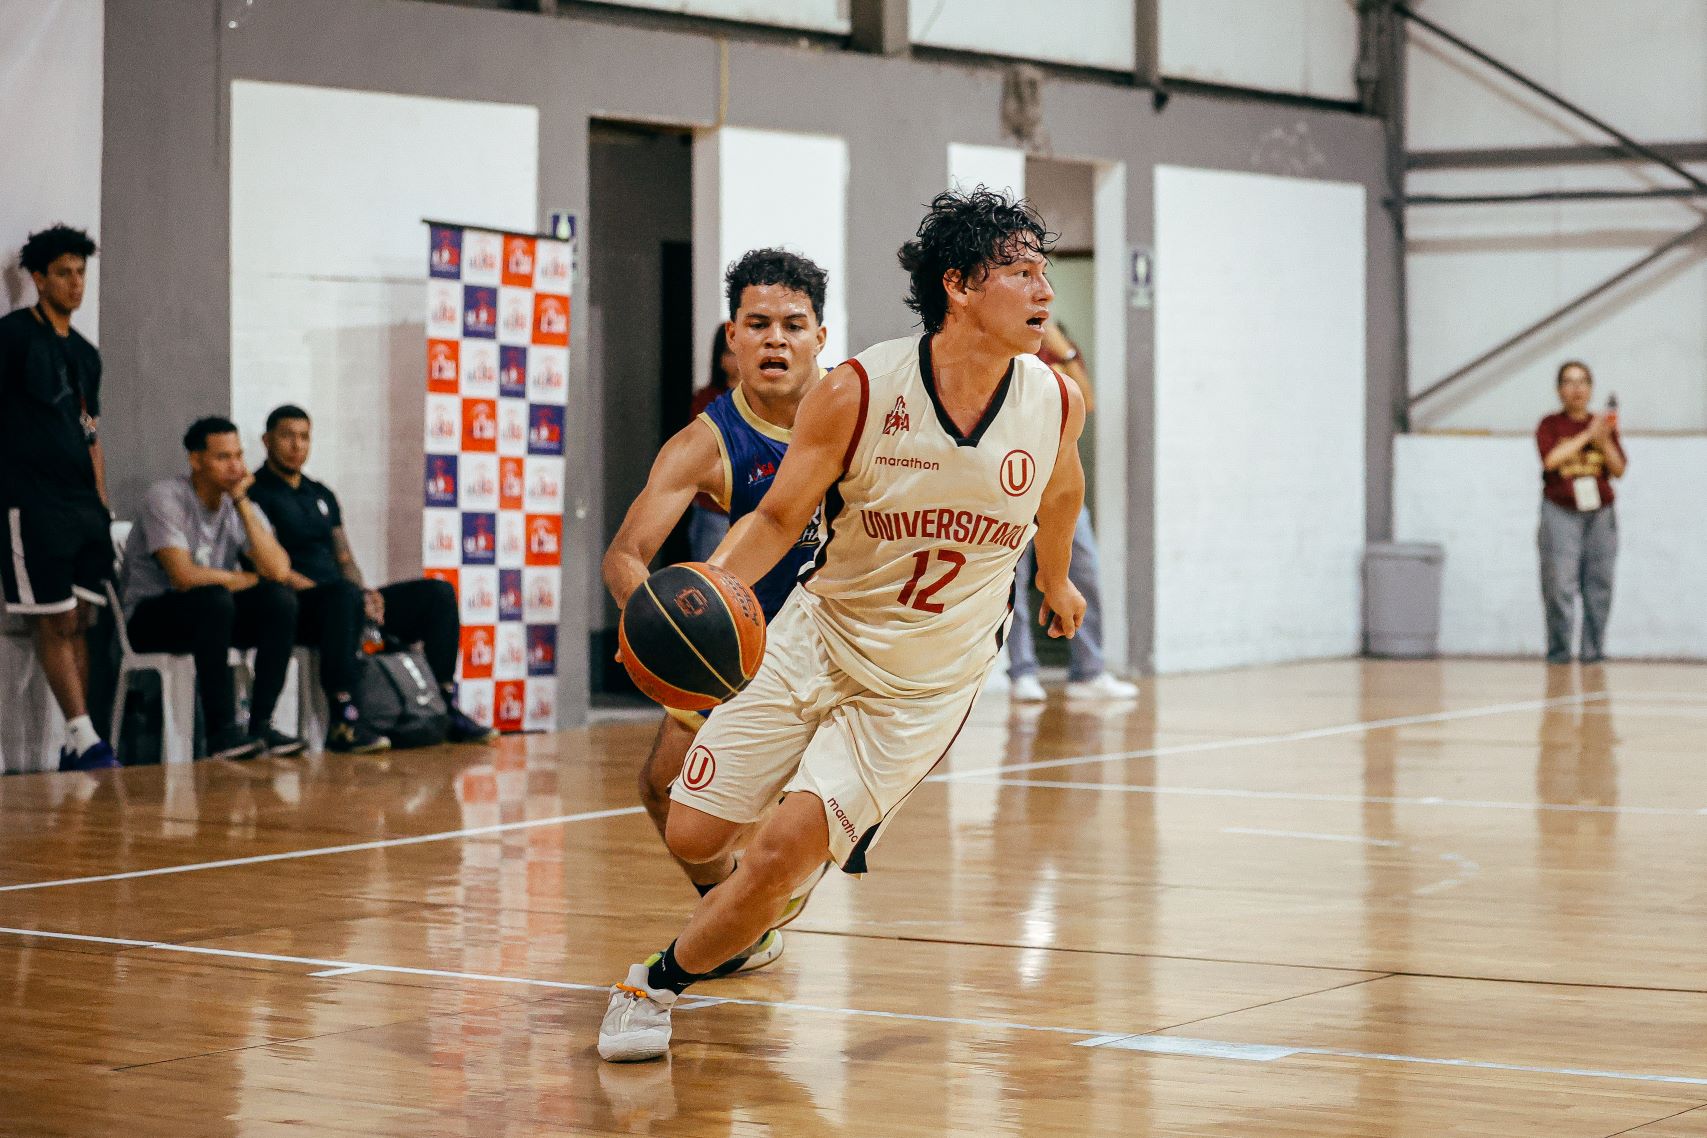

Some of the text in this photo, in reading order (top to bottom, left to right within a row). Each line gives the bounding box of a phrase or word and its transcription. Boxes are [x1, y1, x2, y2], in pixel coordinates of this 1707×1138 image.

[875, 456, 940, 471] marathon
[1008, 457, 1027, 491] U
[897, 550, 966, 613] 12
[687, 752, 709, 785] U
[827, 797, 859, 843] maratho
